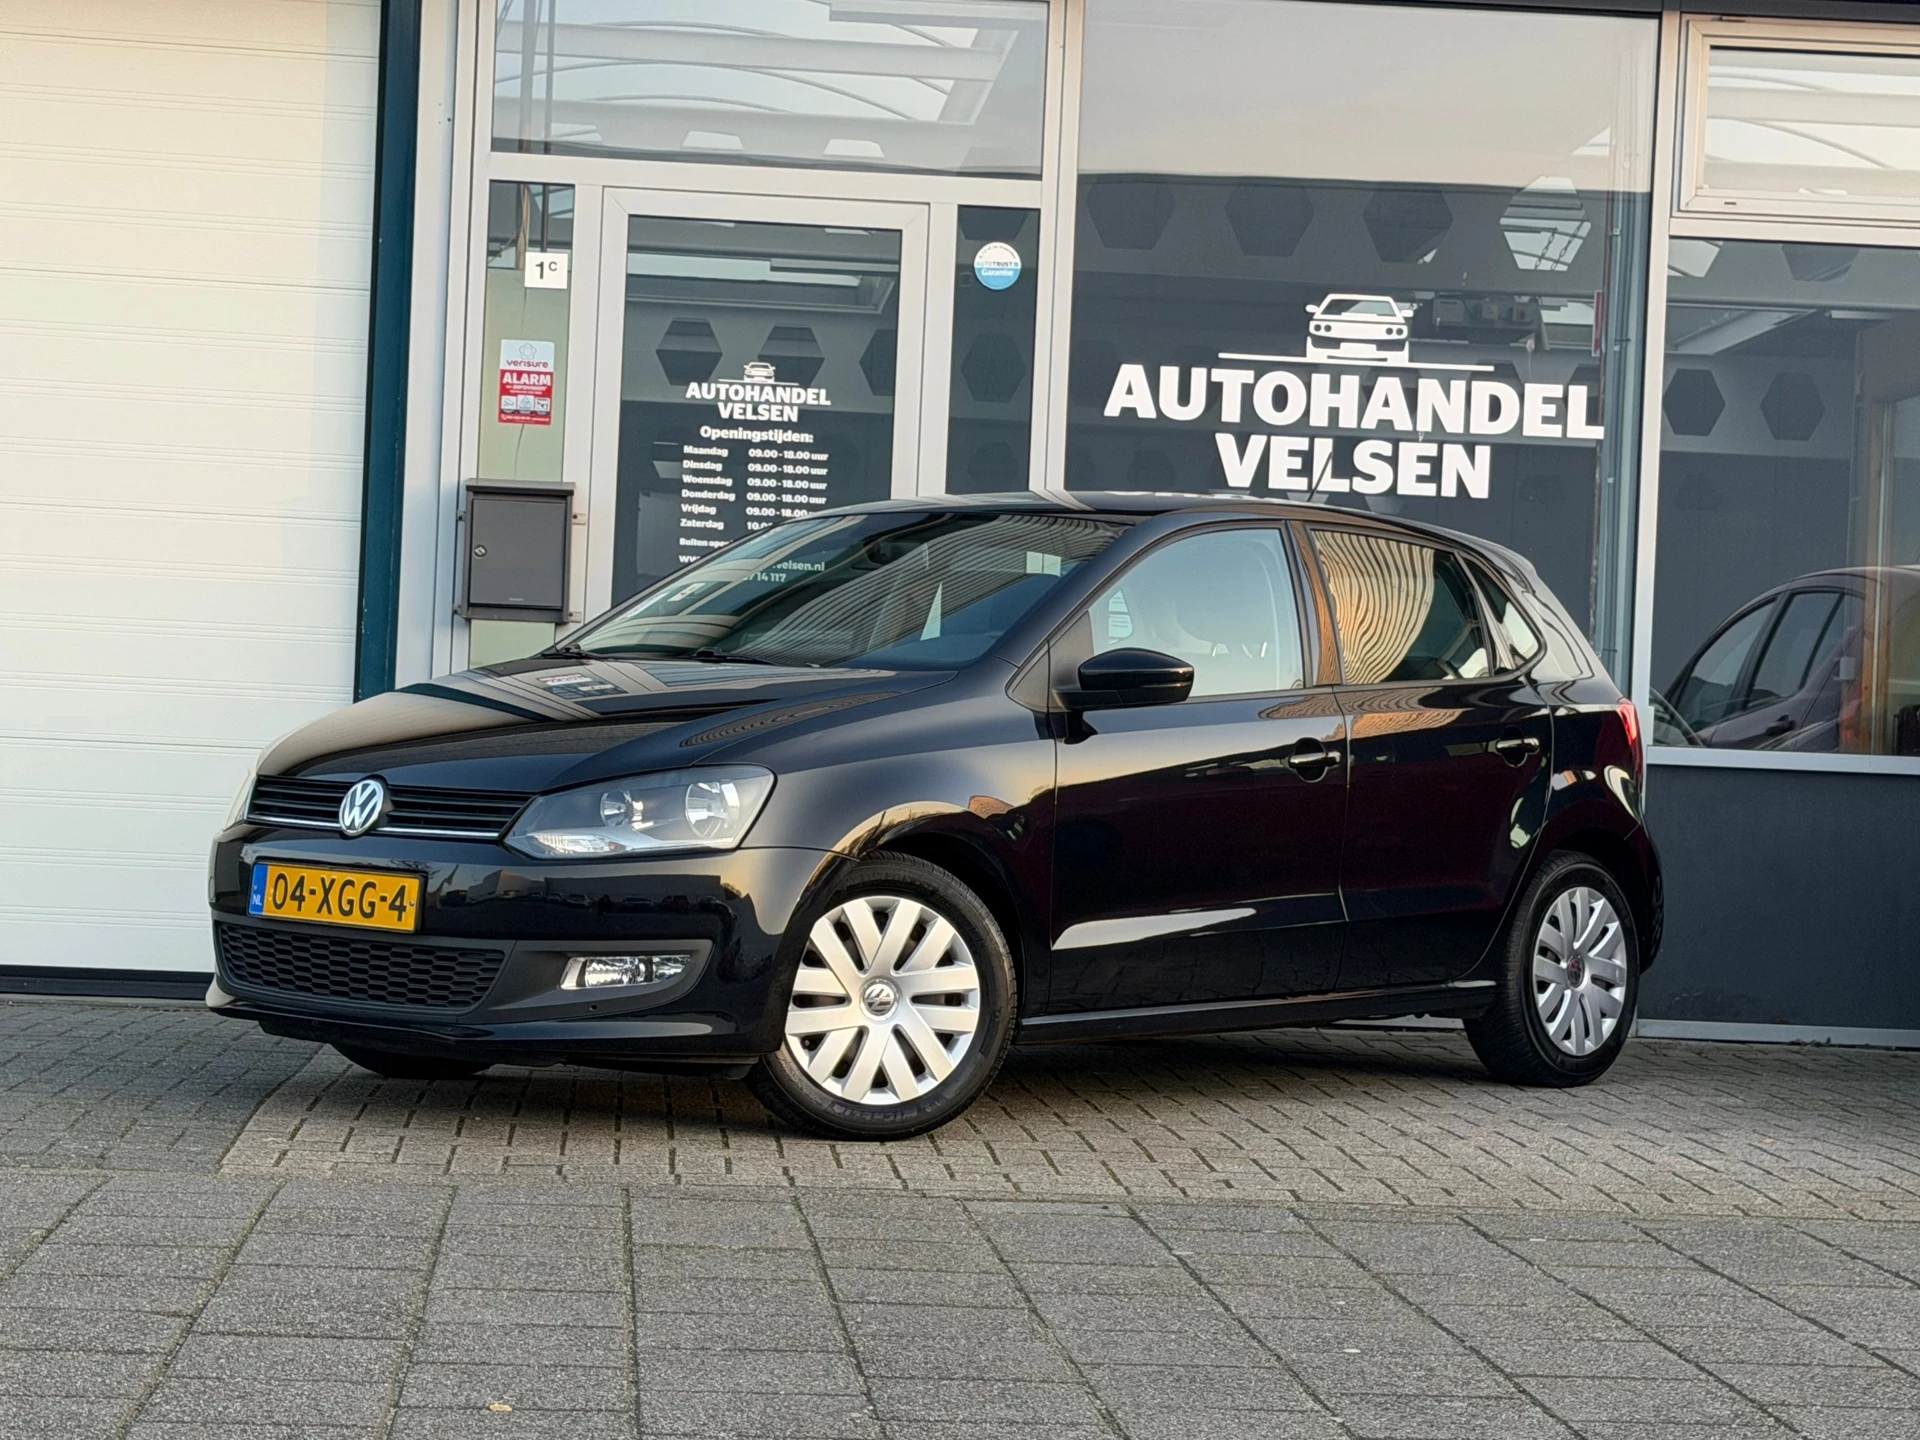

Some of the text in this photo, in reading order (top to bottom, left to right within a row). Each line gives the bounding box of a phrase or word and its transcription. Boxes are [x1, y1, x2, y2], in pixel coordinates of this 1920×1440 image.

[506, 359, 549, 369] verisure
[502, 372, 552, 386] ALARM
[685, 382, 832, 406] AUTOHANDEL
[1103, 363, 1605, 440] AUTOHANDEL
[717, 402, 799, 422] VELSEN
[700, 425, 814, 444] Openingstijden:
[682, 445, 729, 458] Maandag
[748, 448, 778, 458] 09.00
[783, 450, 810, 460] 18.00
[810, 453, 829, 461] uur
[682, 460, 723, 472] Dinsdag
[747, 462, 778, 473] 09.00
[782, 464, 810, 474] 18.00
[810, 468, 828, 476] uur
[1214, 432, 1491, 500] VELSEN
[682, 474, 733, 487] Woensdag
[746, 477, 777, 488] 09.00
[782, 480, 810, 489] 18.00
[810, 482, 828, 490] uur
[681, 488, 736, 502] Donderdag
[746, 492, 776, 502] 09.00
[781, 494, 808, 504] 18.00
[680, 503, 717, 516] Vrijdag
[746, 506, 776, 516] 09.00
[680, 518, 724, 530] Zaterdag
[678, 537, 708, 547] Buiten
[772, 560, 826, 572] velsen.nl
[770, 573, 786, 582] 117
[252, 894, 262, 906] NL
[272, 872, 407, 922] 04-XGG-4
